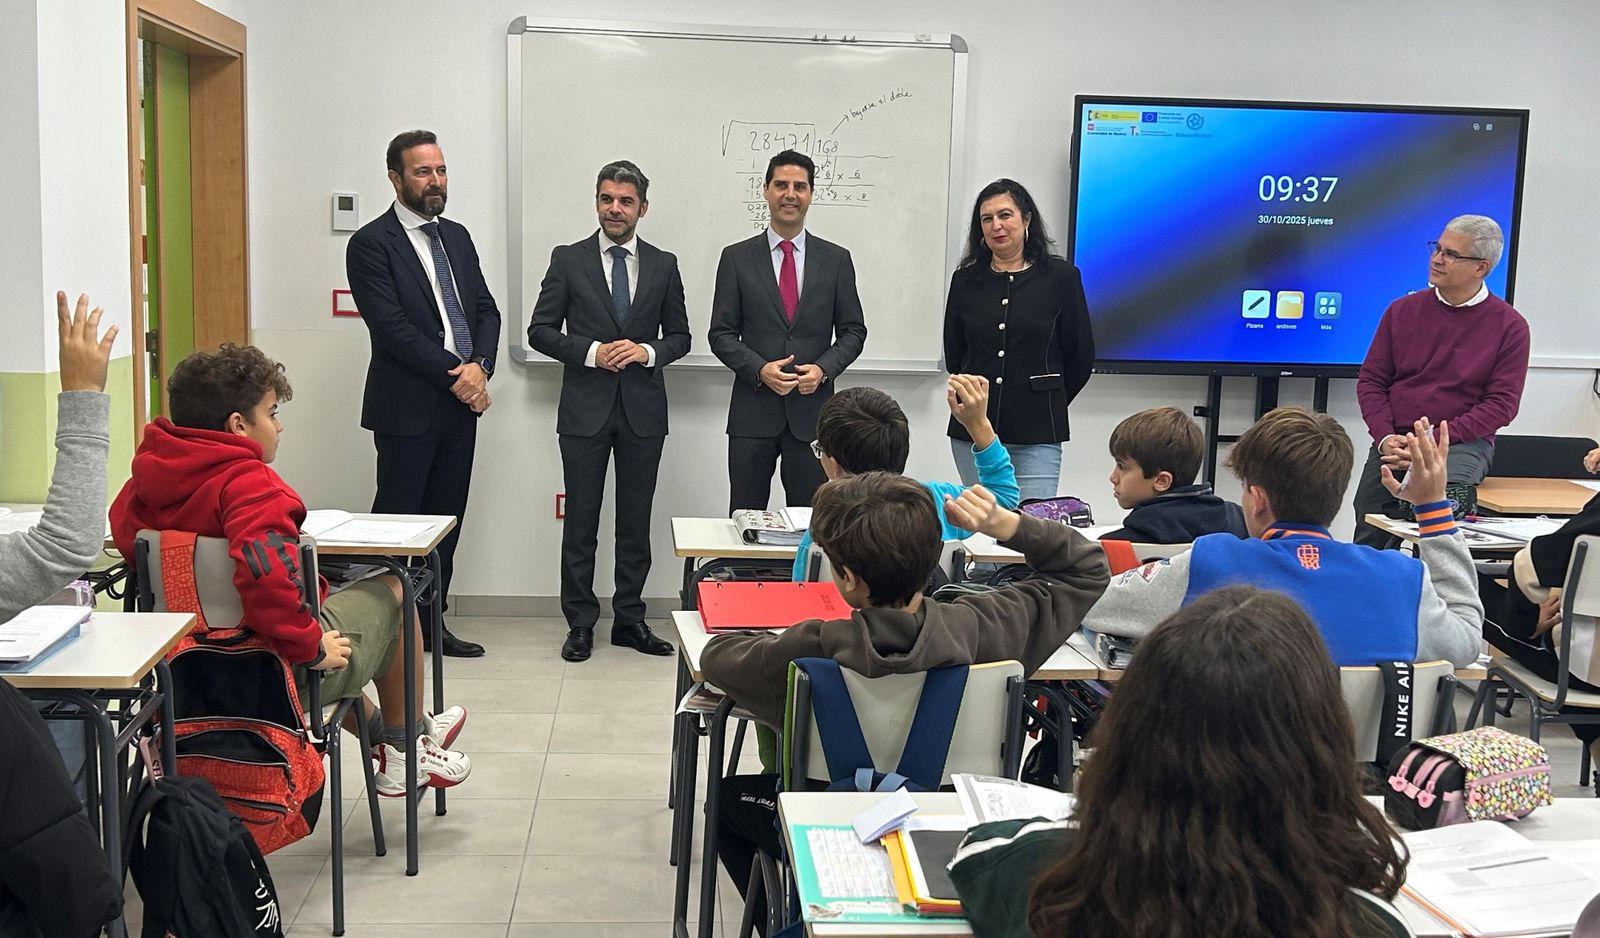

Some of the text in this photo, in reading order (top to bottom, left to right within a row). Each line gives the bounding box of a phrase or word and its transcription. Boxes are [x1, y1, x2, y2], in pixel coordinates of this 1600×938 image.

[749, 131, 810, 153] 28471
[816, 139, 839, 154] 168
[1258, 175, 1339, 203] 09:37
[1257, 214, 1334, 227] 30/10/2025 jueves
[1245, 322, 1264, 330] Pizarra
[1275, 323, 1298, 331] archivos
[1394, 694, 1410, 738] NIKE
